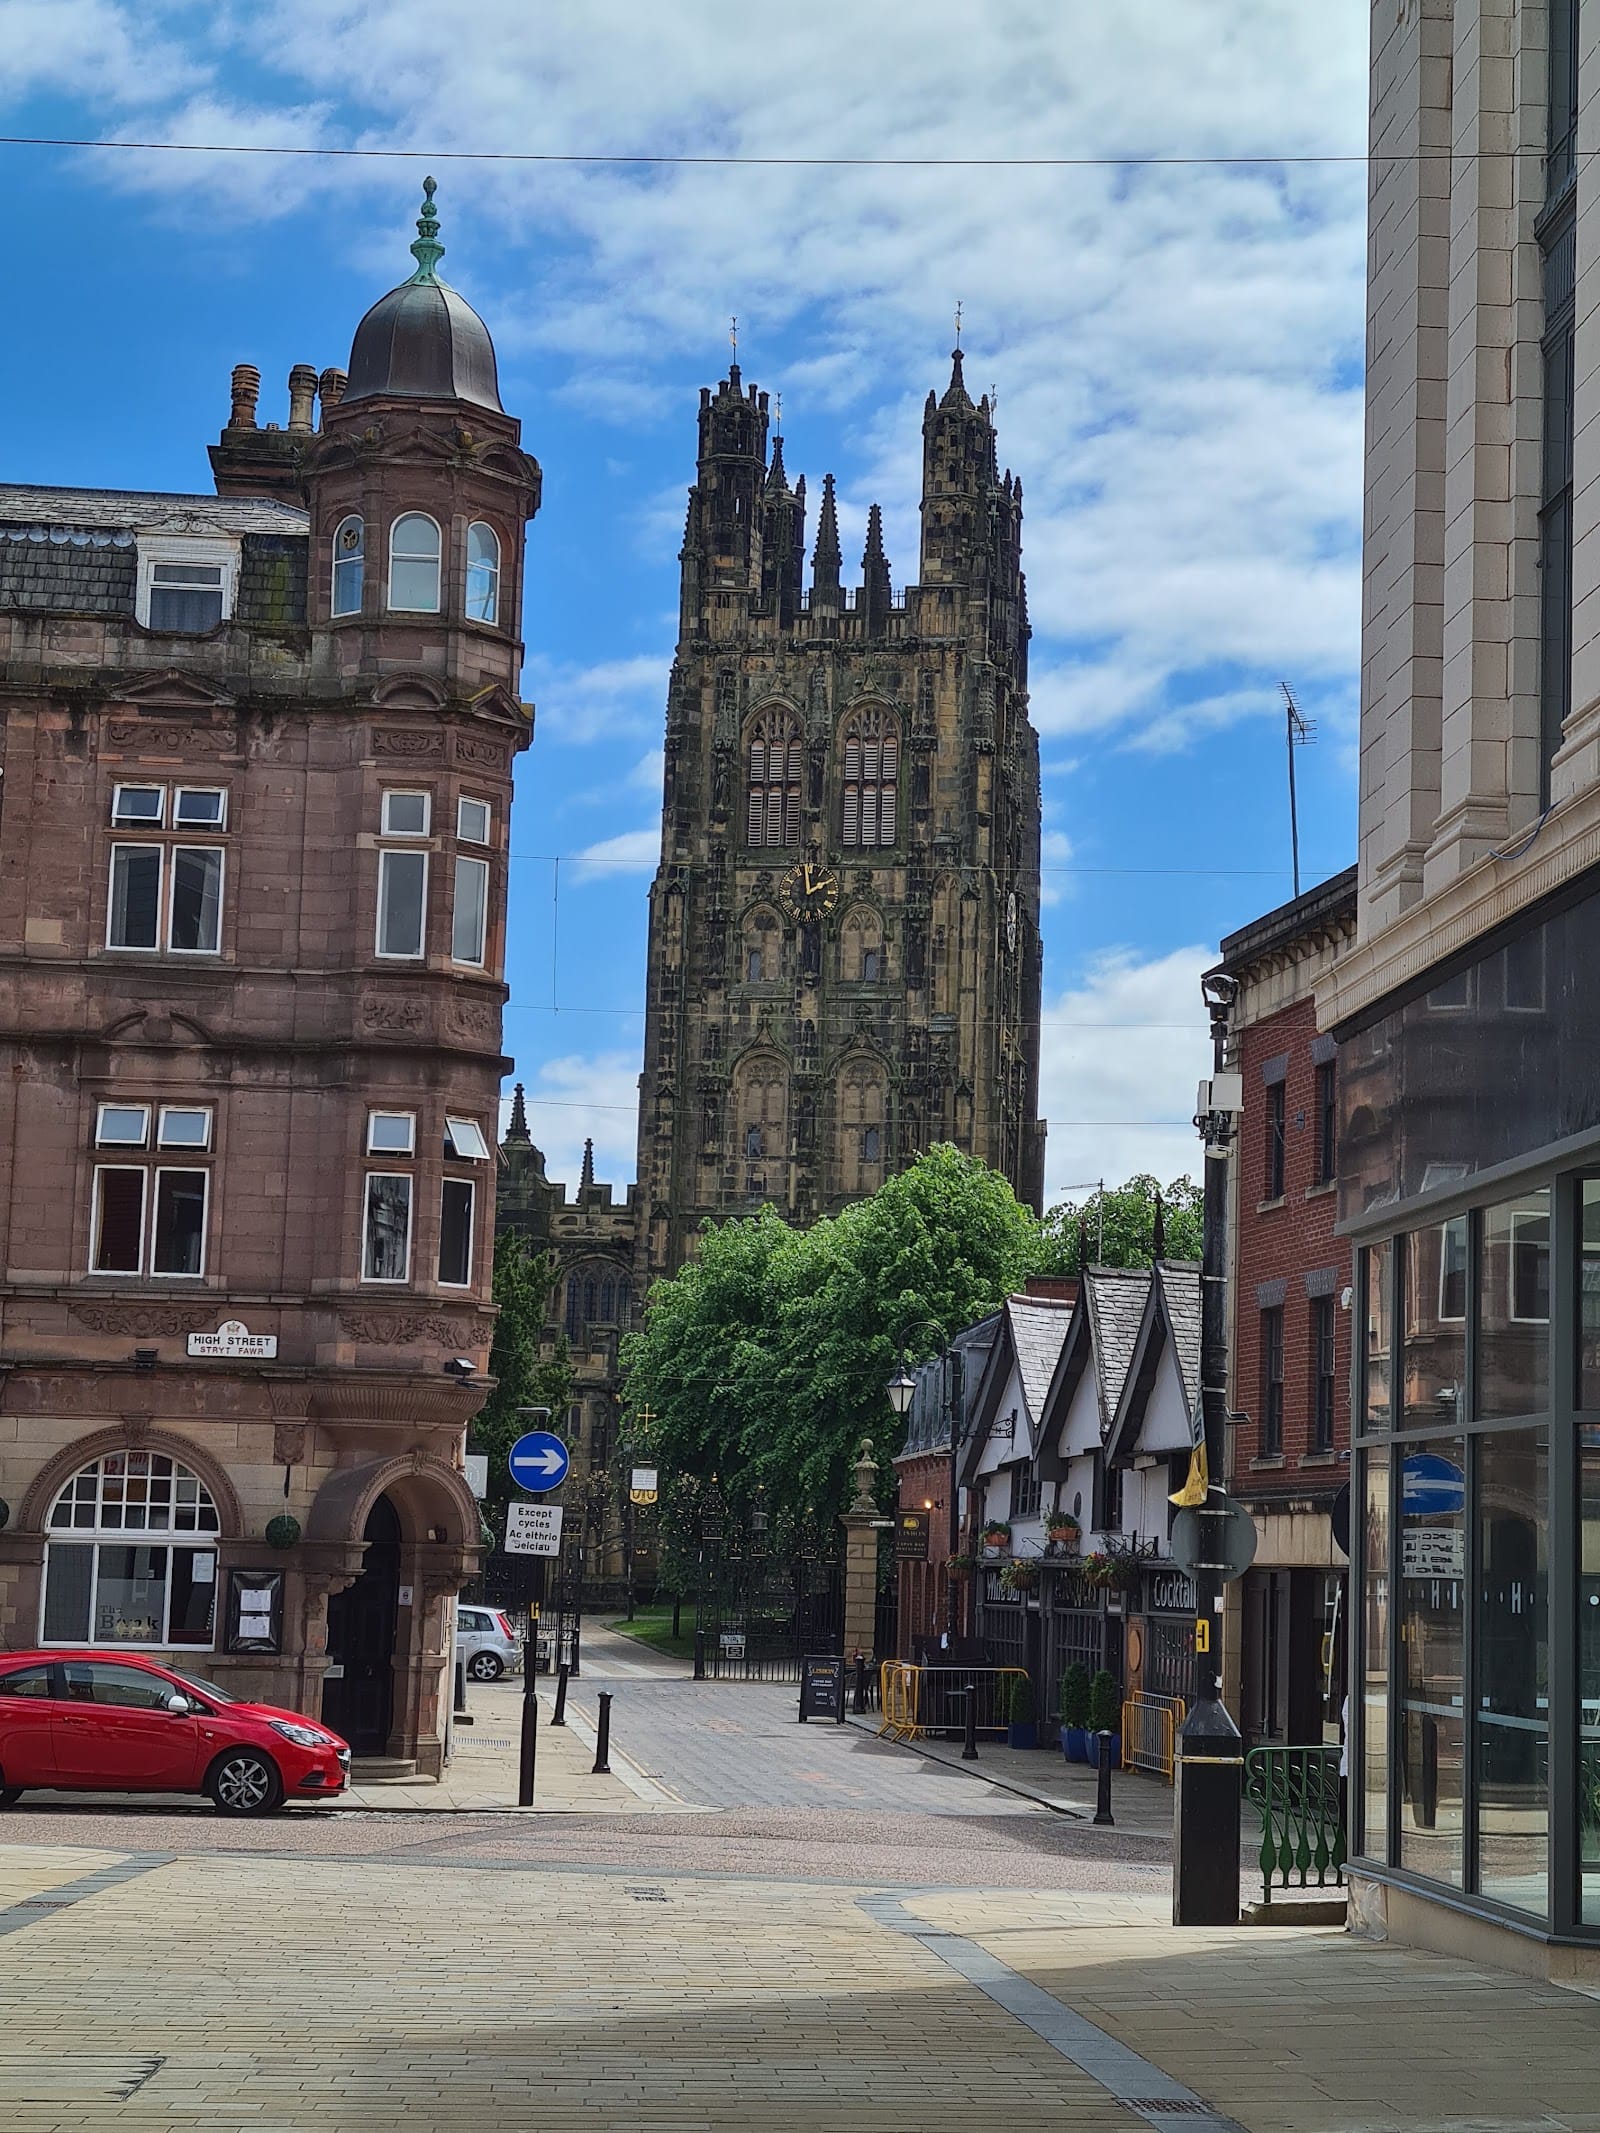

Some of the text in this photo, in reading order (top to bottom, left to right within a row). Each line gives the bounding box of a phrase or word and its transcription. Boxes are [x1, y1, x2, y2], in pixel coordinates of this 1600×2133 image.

[194, 1336, 271, 1346] HIGH STREET
[200, 1346, 230, 1354] STRYT
[518, 1507, 552, 1518] Except
[518, 1520, 550, 1528] cycles
[509, 1530, 557, 1541] Ac eithrio
